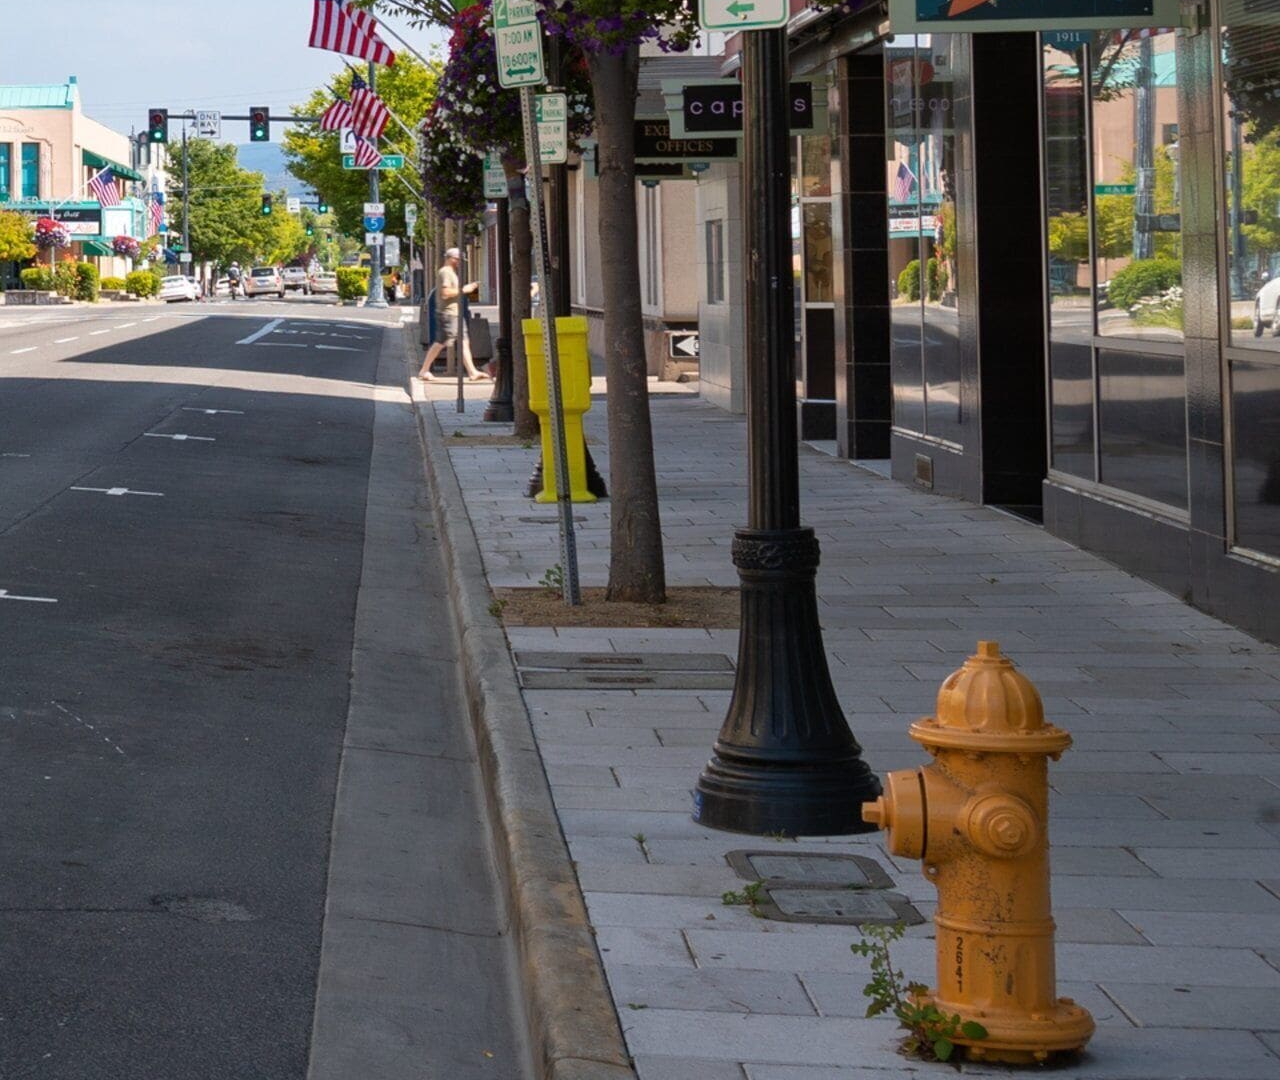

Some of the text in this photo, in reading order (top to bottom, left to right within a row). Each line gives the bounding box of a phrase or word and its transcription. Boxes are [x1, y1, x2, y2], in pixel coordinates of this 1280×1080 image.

[509, 4, 534, 18] PARKING
[503, 30, 533, 45] 7:00 AM
[1056, 32, 1080, 42] 1911
[690, 97, 806, 118] caps
[656, 141, 713, 152] OFFICES
[371, 219, 378, 227] 5
